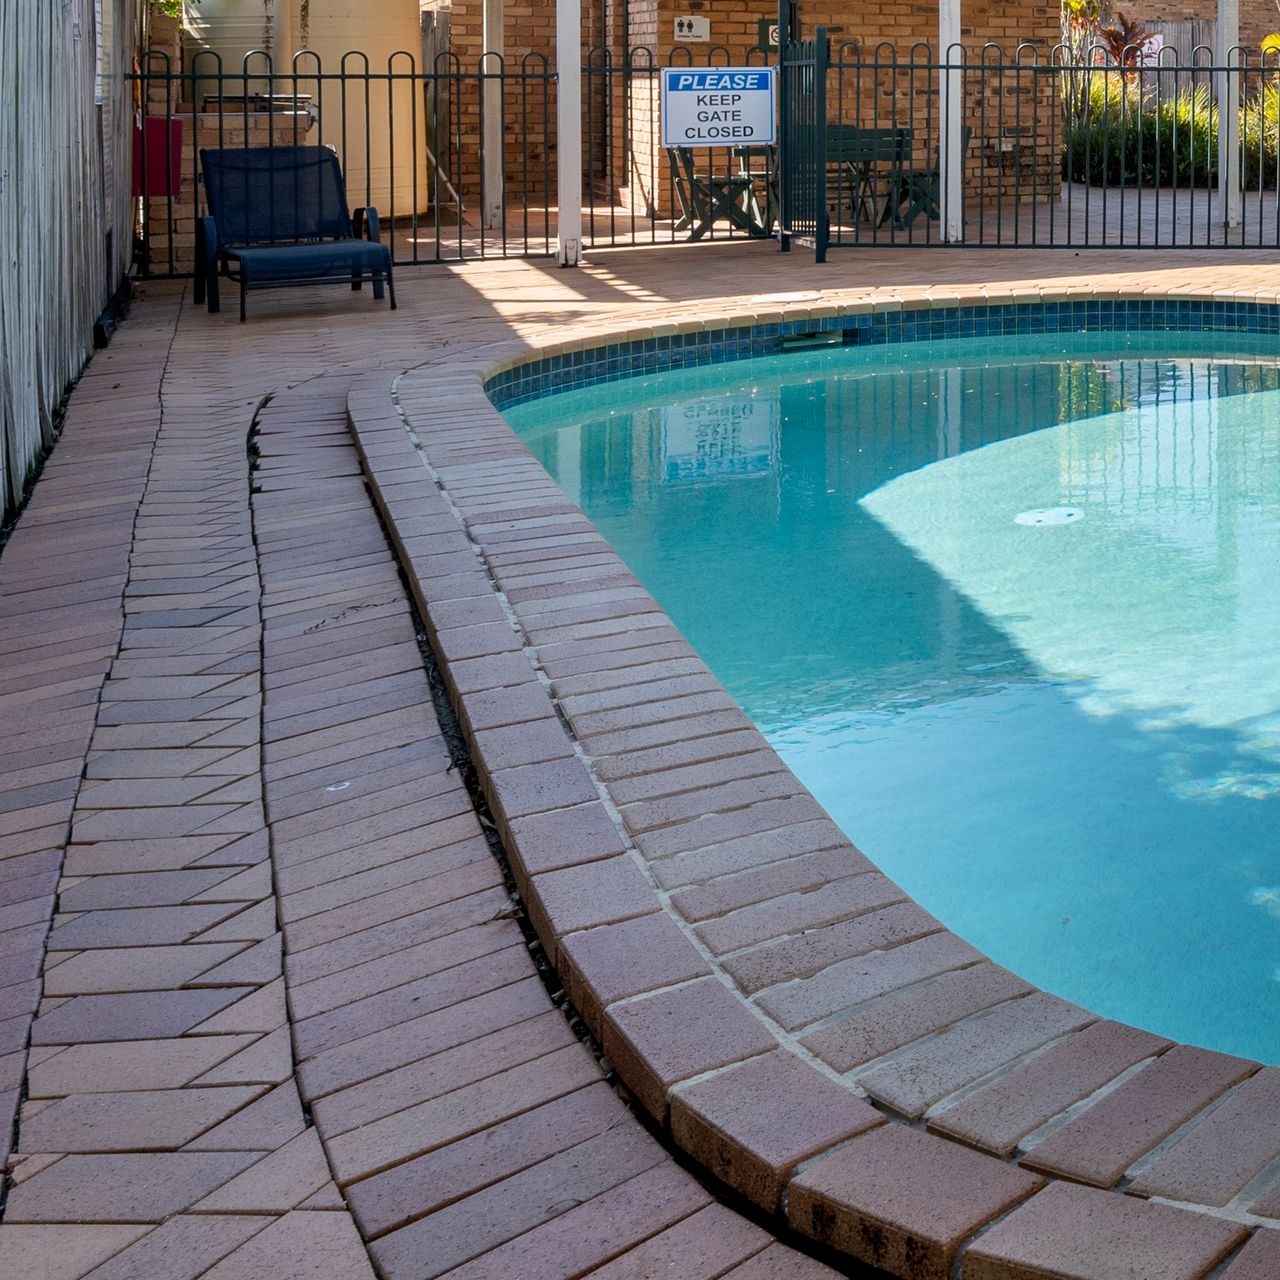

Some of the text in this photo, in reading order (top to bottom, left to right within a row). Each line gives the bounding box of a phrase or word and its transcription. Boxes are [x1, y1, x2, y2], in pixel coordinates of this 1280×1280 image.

[678, 74, 760, 90] PLEASE
[696, 94, 742, 106] KEEP
[696, 110, 742, 123] GATE
[684, 125, 754, 139] CLOSED
